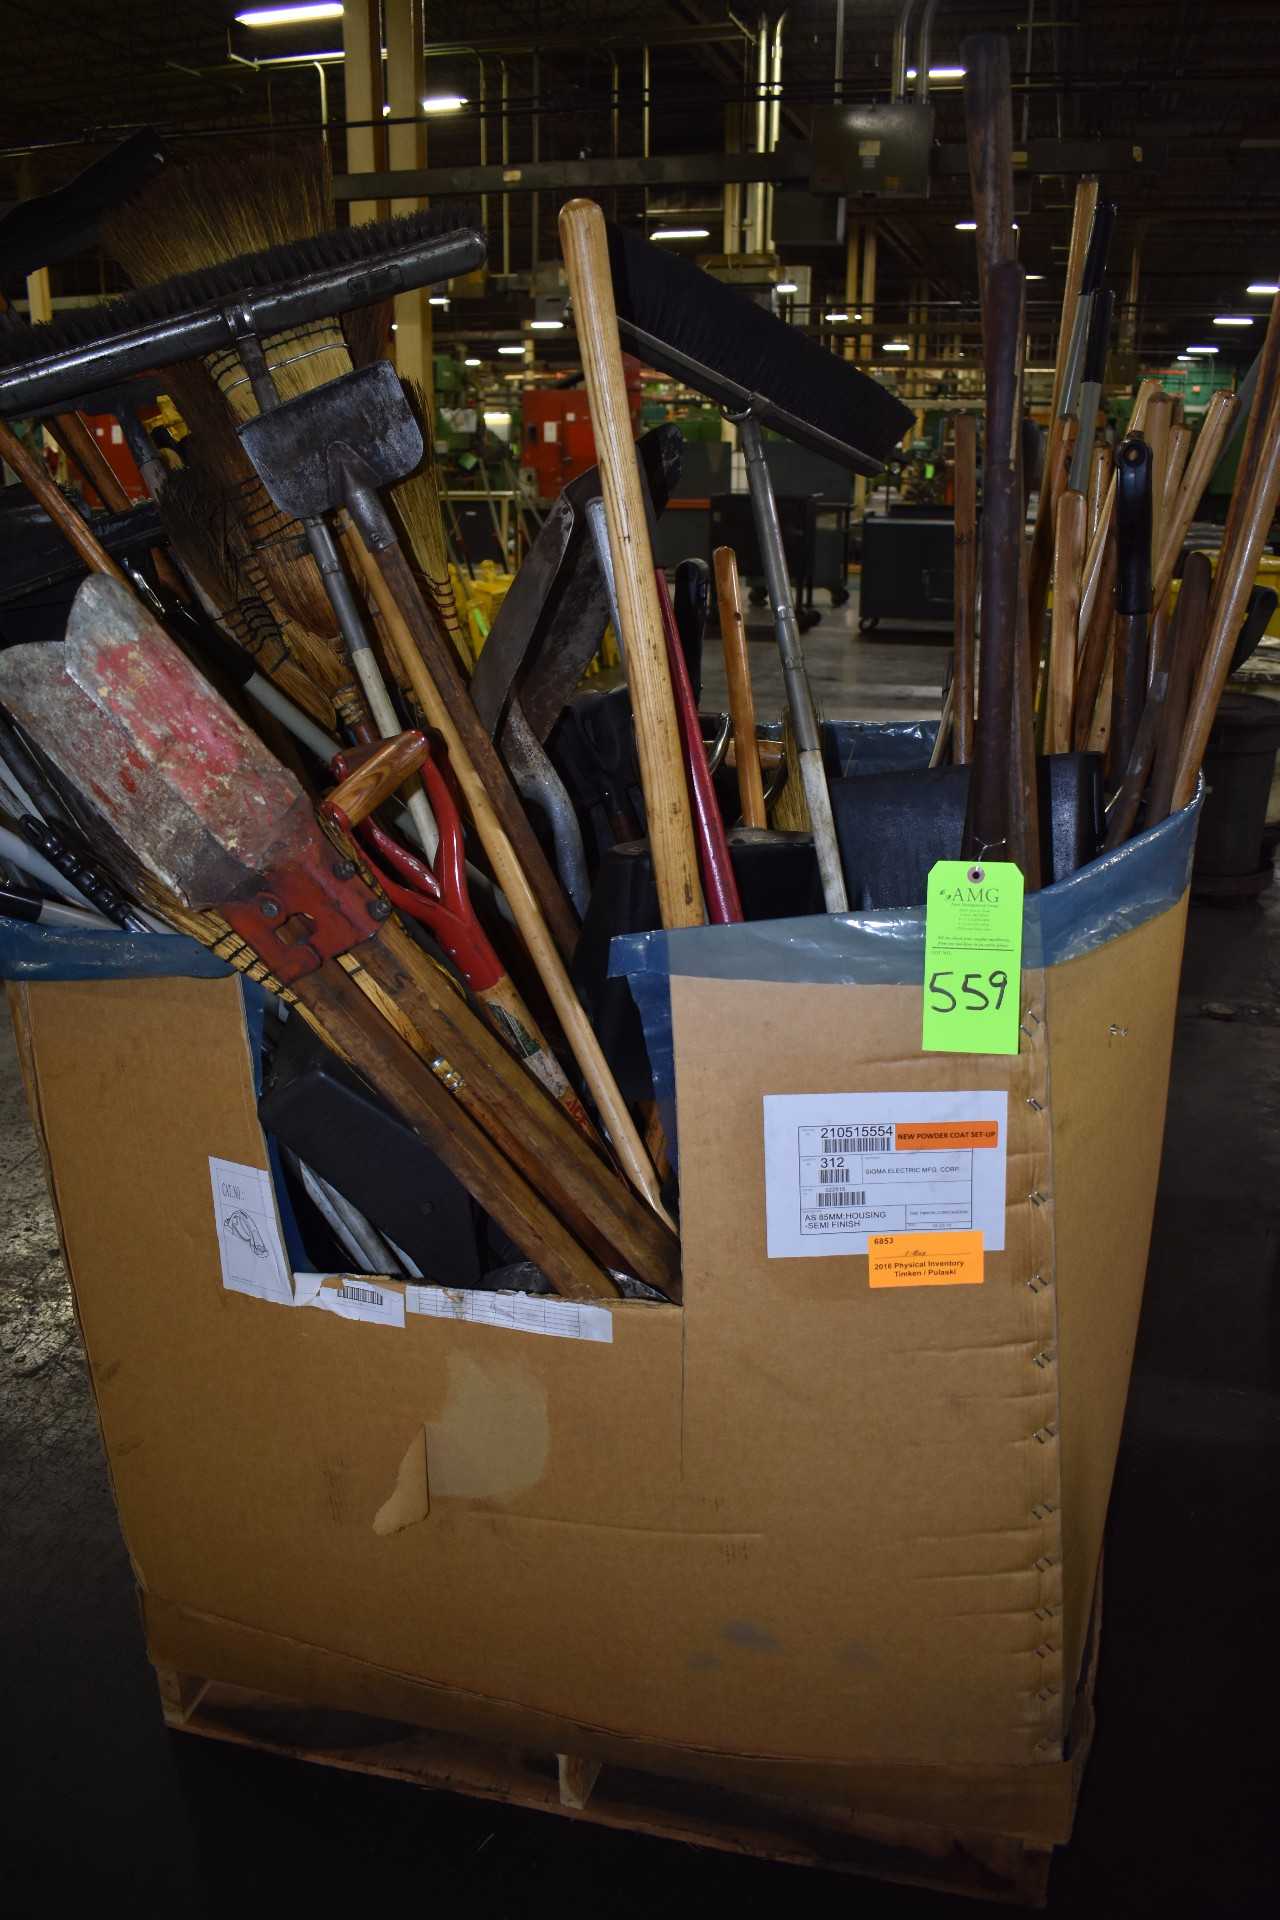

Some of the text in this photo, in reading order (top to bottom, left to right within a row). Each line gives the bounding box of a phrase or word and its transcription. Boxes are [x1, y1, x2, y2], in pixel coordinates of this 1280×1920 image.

[952, 888, 999, 903] AMG
[928, 970, 1008, 1014] 559
[820, 1126, 893, 1139] 210515554
[916, 1132, 949, 1140] POWDER
[820, 1157, 845, 1168] 312
[831, 1220, 861, 1228] FINISH
[894, 1260, 926, 1269] Physical
[928, 1259, 964, 1268] Inventory
